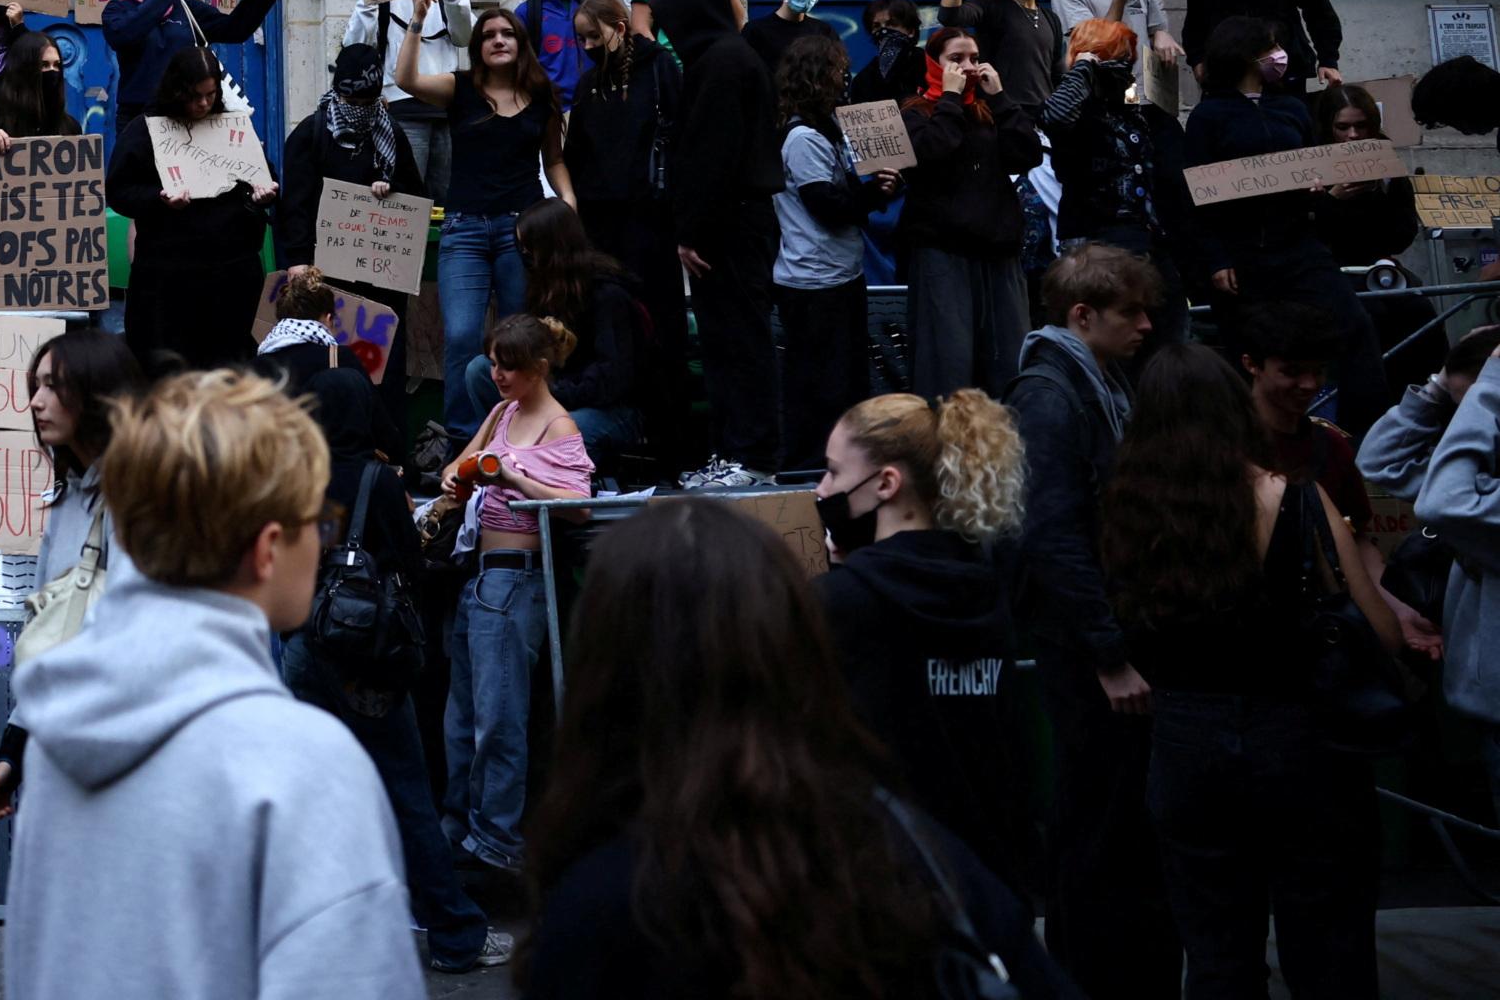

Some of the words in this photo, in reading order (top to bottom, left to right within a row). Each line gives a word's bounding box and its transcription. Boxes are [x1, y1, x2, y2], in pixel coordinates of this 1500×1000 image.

[1241, 144, 1333, 171] PARCOURSUP
[1194, 184, 1218, 200] ON
[1232, 173, 1280, 194] VEND
[1292, 167, 1324, 184] DES
[1332, 158, 1388, 179] STUPS
[55, 180, 104, 221] TES
[331, 189, 349, 201] JE
[320, 219, 332, 227] EN
[338, 222, 367, 233] COURS
[372, 227, 389, 237] QUE
[350, 209, 362, 217] DE
[368, 212, 409, 227] TEMPS
[65, 225, 106, 264] PAS
[327, 236, 345, 247] PAS
[353, 238, 364, 248] LE
[402, 247, 412, 256] DE
[356, 257, 367, 268] ME
[4, 267, 108, 307] NÔTRES
[927, 657, 1003, 696] FRENCHY
